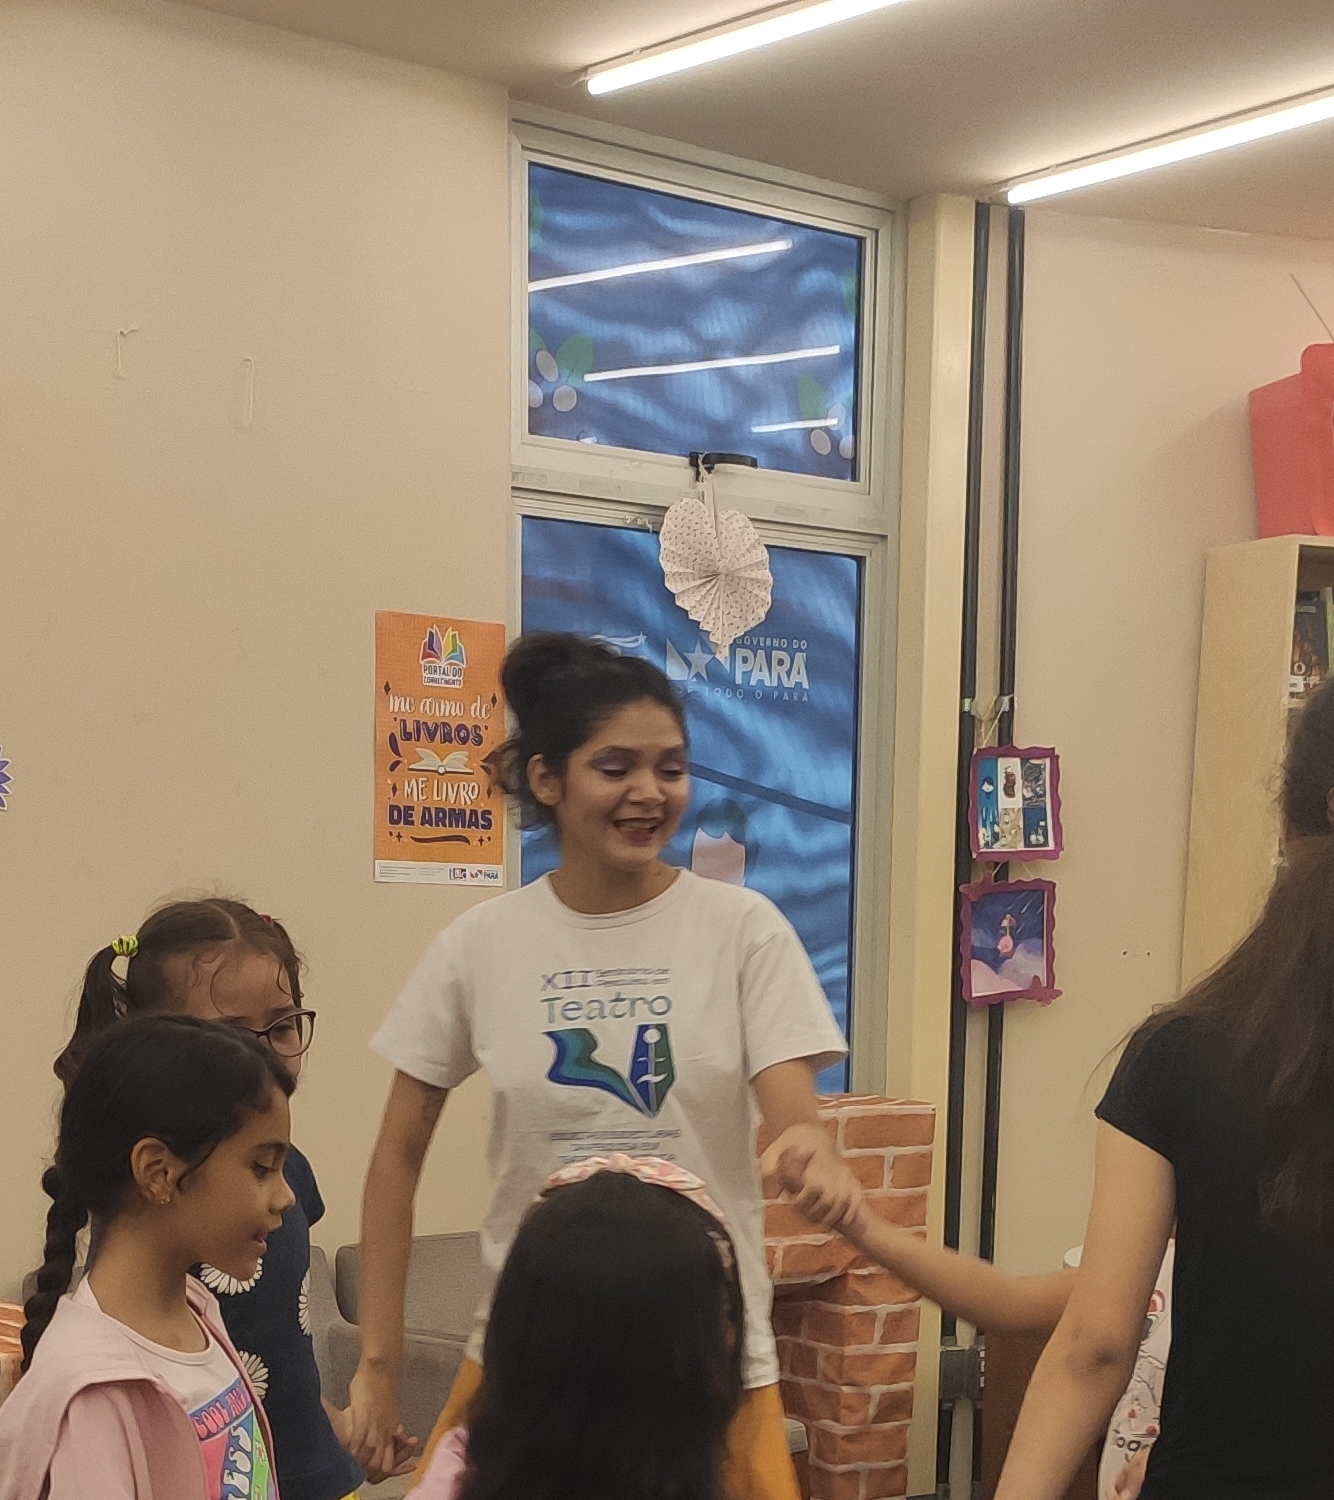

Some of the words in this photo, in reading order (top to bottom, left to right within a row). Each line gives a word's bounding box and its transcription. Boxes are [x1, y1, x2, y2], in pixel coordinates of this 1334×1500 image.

[792, 639, 809, 649] DO
[452, 667, 463, 678] DO
[399, 718, 484, 747] LIVROS
[404, 778, 428, 802] ME
[433, 779, 480, 806] LIVRO
[388, 804, 416, 827] DE
[419, 806, 493, 831] ARMAS
[540, 969, 594, 992] XII
[540, 991, 673, 1024] Teatro
